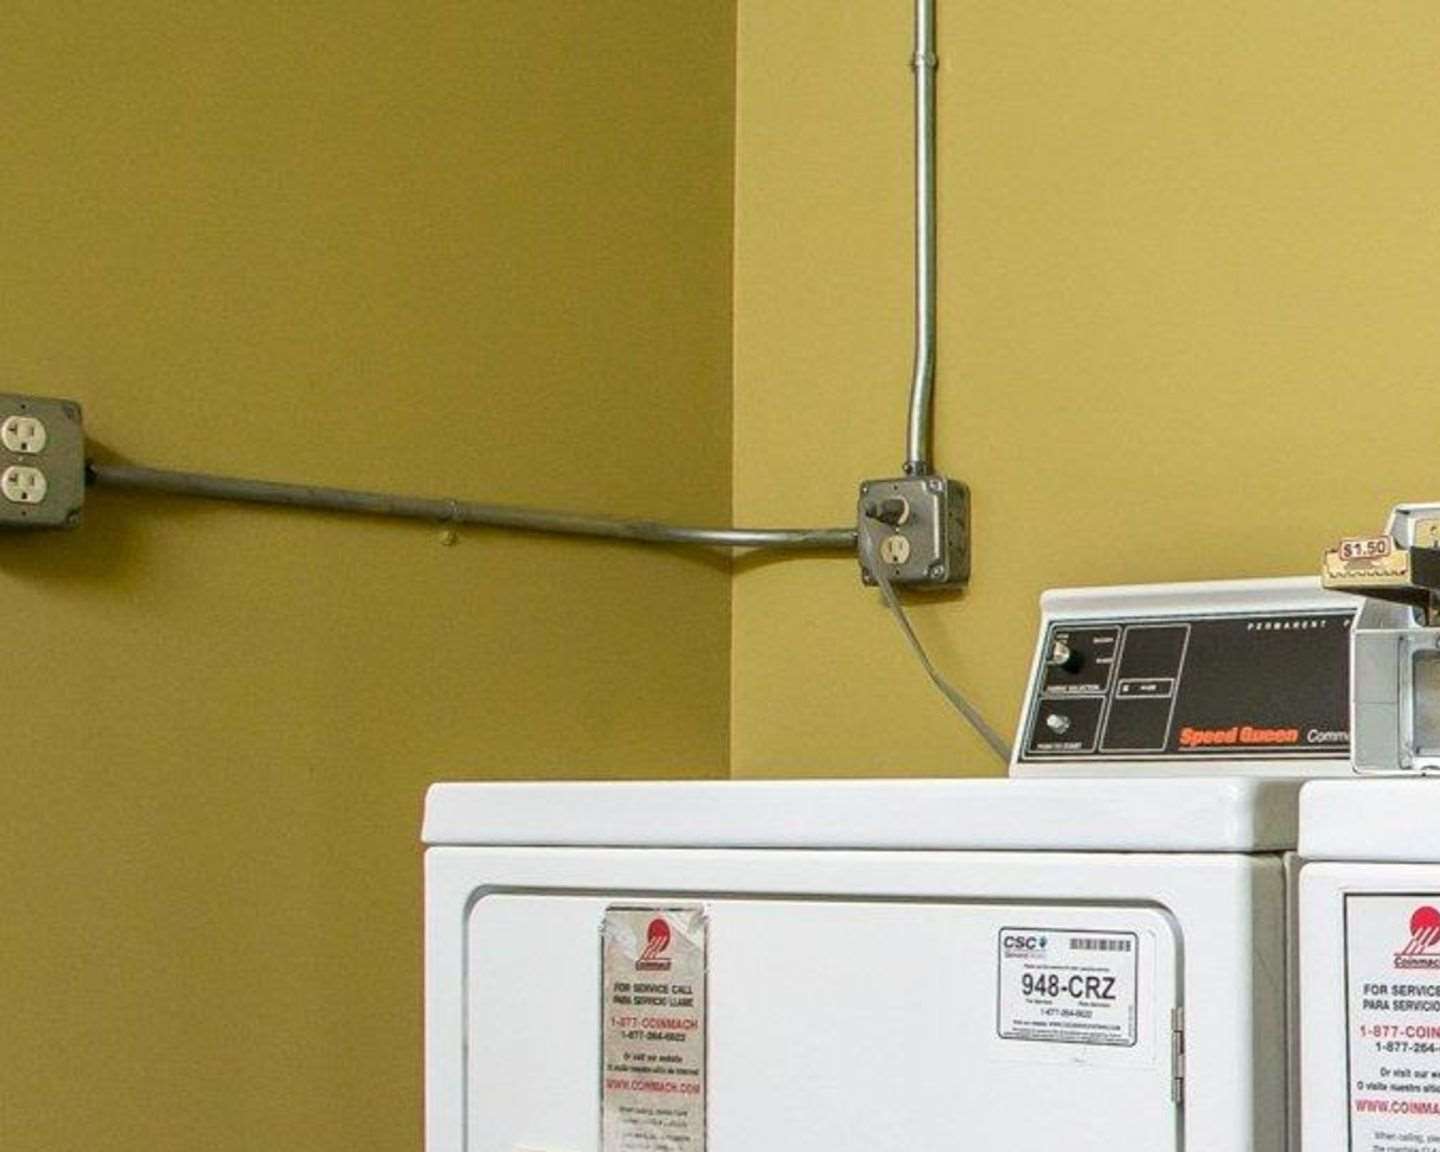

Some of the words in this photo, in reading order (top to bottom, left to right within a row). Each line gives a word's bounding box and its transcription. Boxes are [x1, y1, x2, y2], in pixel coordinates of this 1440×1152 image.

[1342, 540, 1386, 558] $1.50
[1180, 727, 1238, 747] Speed
[1240, 727, 1299, 743] Queen
[1004, 936, 1037, 950] CSC
[633, 983, 668, 994] SERVICE
[1022, 973, 1116, 1000] 948-CRZ
[1363, 984, 1388, 995] FOR
[1363, 1000, 1390, 1011] PARA
[1392, 1001, 1440, 1012] SERVICIO
[1380, 1067, 1390, 1077] Or
[1394, 1068, 1411, 1078] visit
[1414, 1070, 1429, 1078] our
[1357, 1081, 1364, 1090] O
[1366, 1082, 1388, 1091] visite
[1390, 1083, 1421, 1093] nuestro
[1423, 1084, 1440, 1094] sitio
